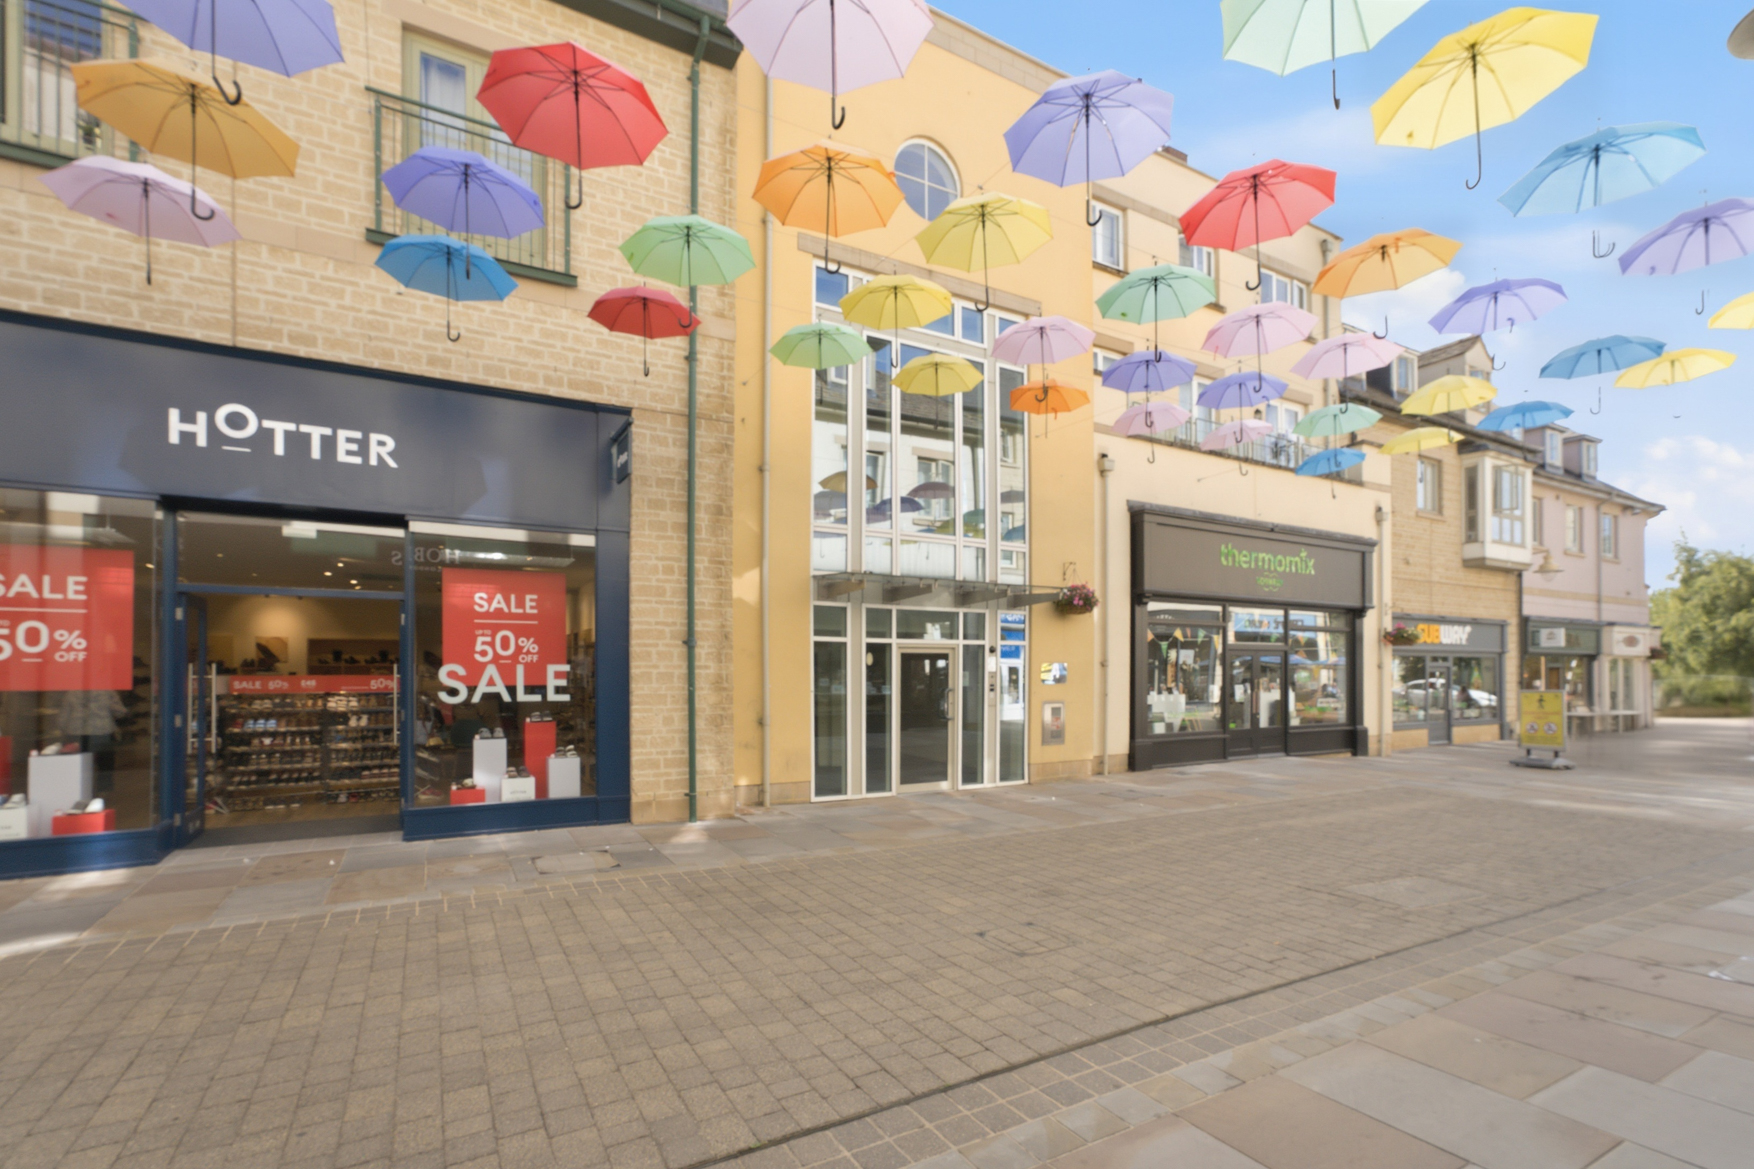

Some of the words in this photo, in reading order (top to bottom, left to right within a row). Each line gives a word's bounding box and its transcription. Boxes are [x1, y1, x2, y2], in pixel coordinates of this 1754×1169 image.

[168, 403, 398, 468] HOTTER
[1221, 543, 1315, 575] thermomix
[0, 573, 88, 600] ALE
[473, 592, 538, 614] SALE
[473, 630, 539, 662] 50%
[1416, 623, 1472, 645] SUBWAY
[54, 651, 87, 662] OFF
[518, 654, 539, 663] OFF
[232, 680, 262, 690] SALE
[437, 663, 571, 704] SALE
